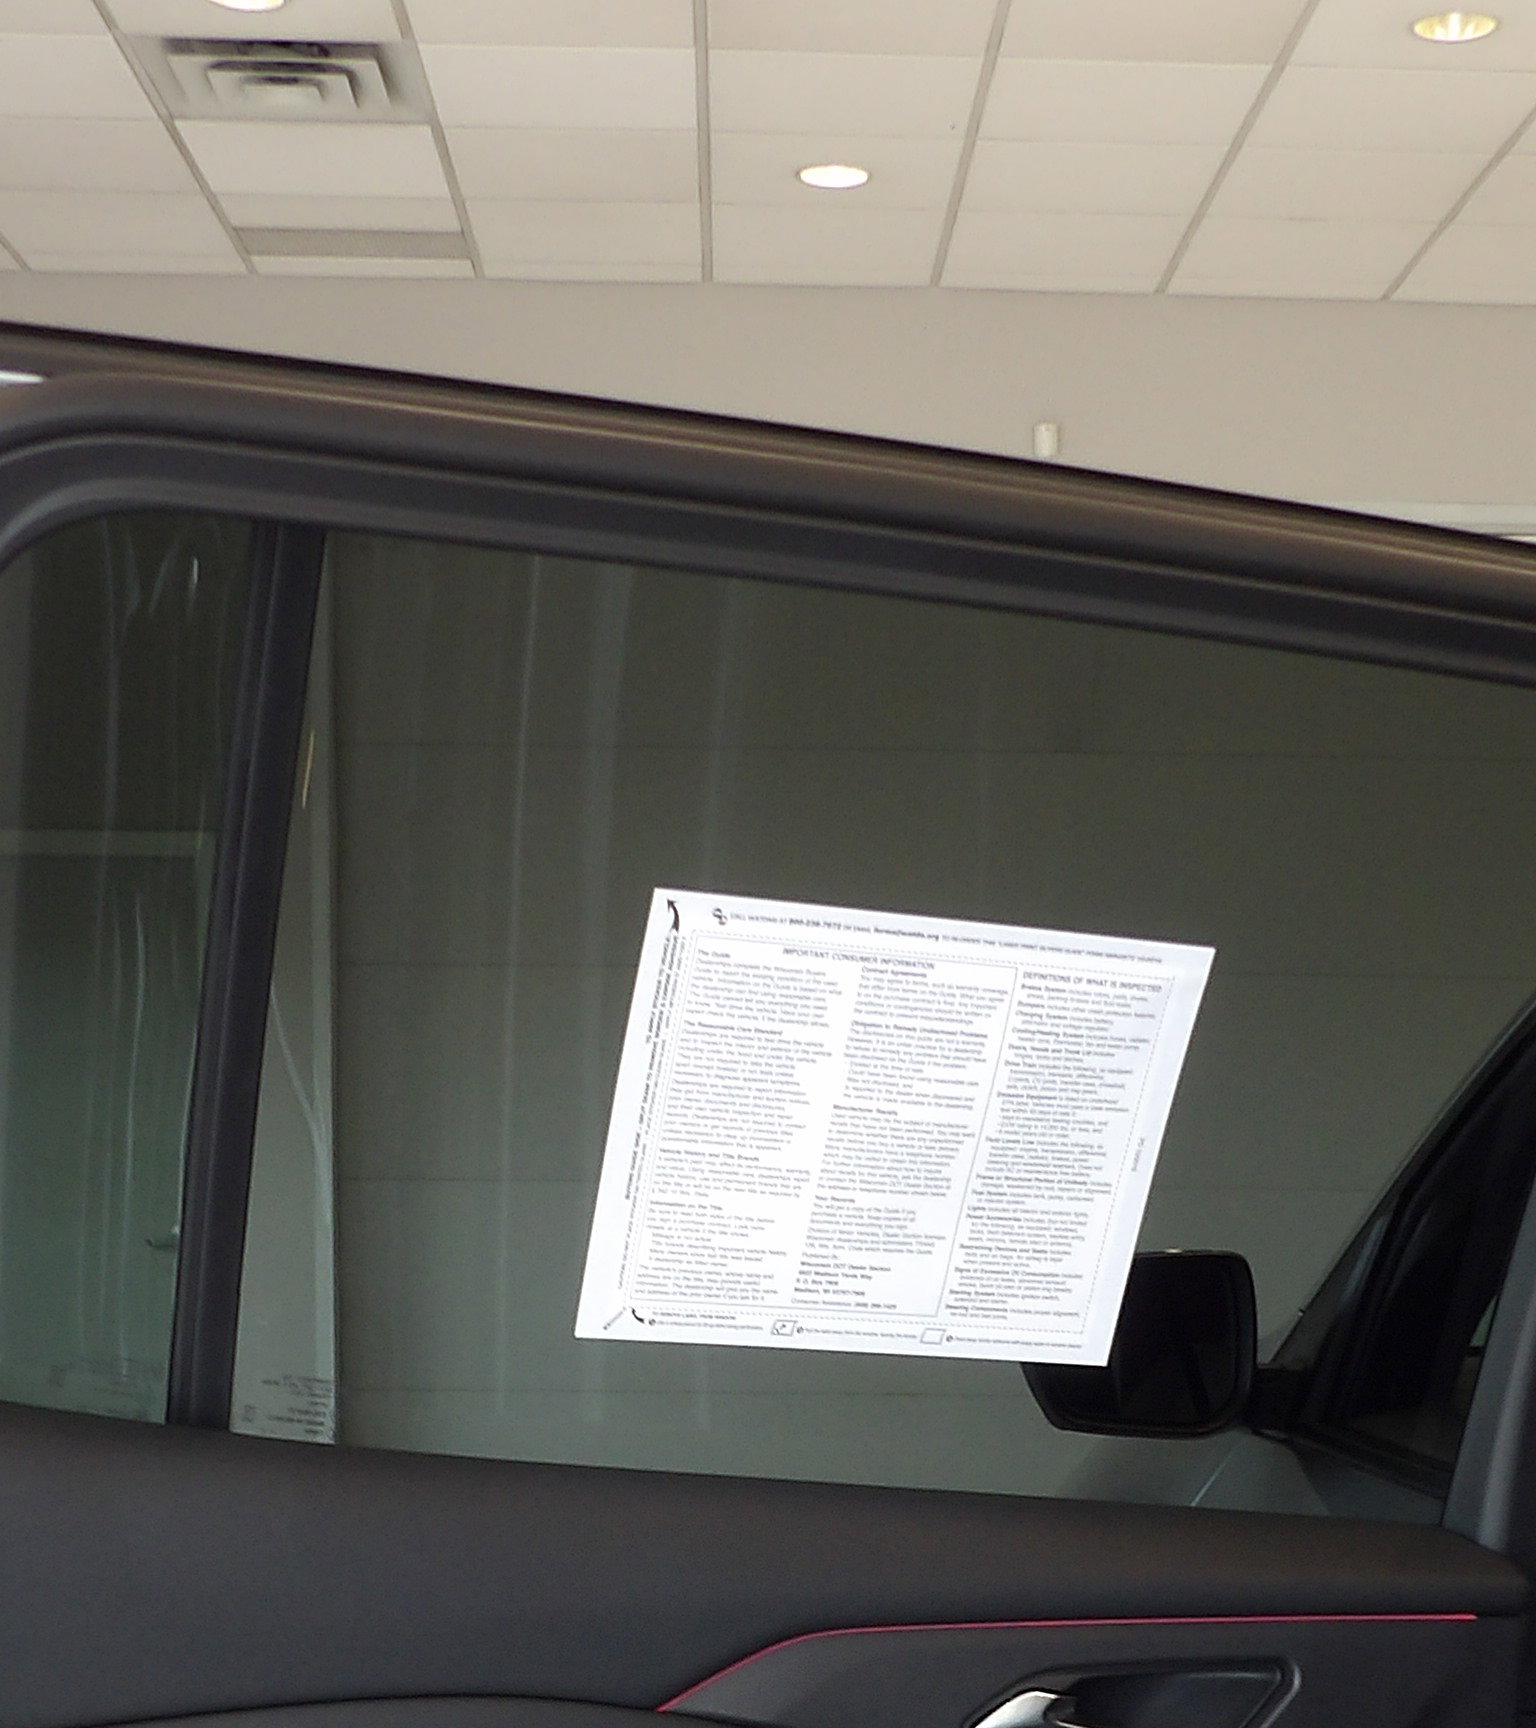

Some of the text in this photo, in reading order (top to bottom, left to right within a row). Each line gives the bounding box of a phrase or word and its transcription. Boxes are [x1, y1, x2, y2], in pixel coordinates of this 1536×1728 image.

[783, 948, 935, 969] IMPORTANT CONSUMER INFORMATION
[1023, 971, 1071, 983] DEFINITIONS
[1086, 978, 1107, 986] WHAT
[1119, 981, 1162, 992] INSPECTED
